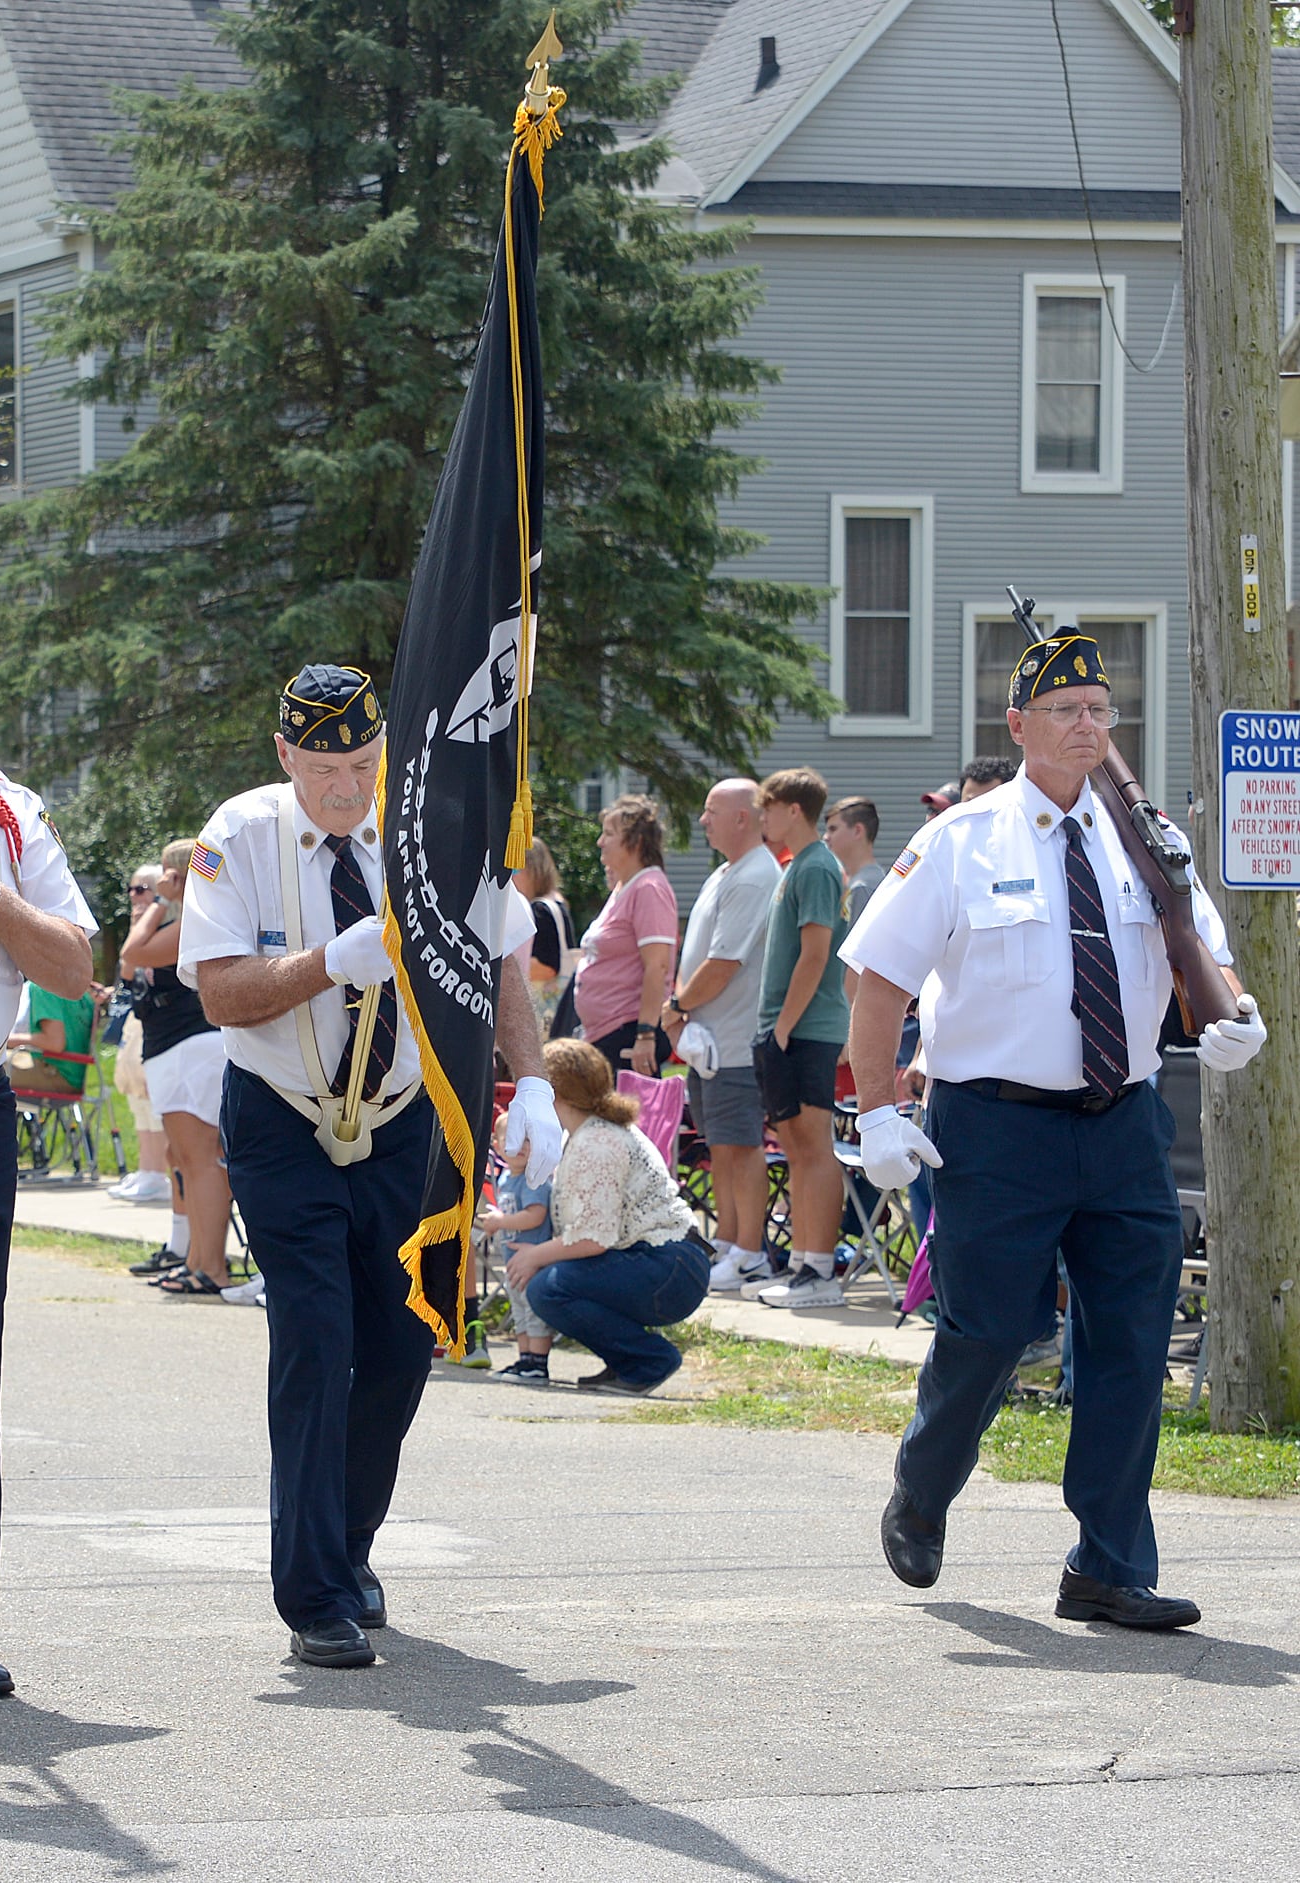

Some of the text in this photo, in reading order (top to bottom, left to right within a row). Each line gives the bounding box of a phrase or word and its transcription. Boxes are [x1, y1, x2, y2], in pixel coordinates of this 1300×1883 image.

[1244, 549, 1255, 575] 037
[1246, 584, 1257, 618] 100W
[1053, 675, 1067, 686] 33
[1235, 717, 1300, 740] SNOW
[314, 740, 329, 750] 33
[1231, 745, 1300, 768] ROUTE
[401, 757, 416, 817] YOU
[1245, 780, 1297, 795] NO PARKING
[1240, 800, 1252, 815] ON
[1253, 800, 1271, 815] ANY
[1232, 820, 1257, 835] AFTER
[397, 829, 415, 884] ARE
[1240, 840, 1281, 855] VEHICLES
[1251, 860, 1292, 875] BE TOWED
[404, 888, 425, 942] NOT
